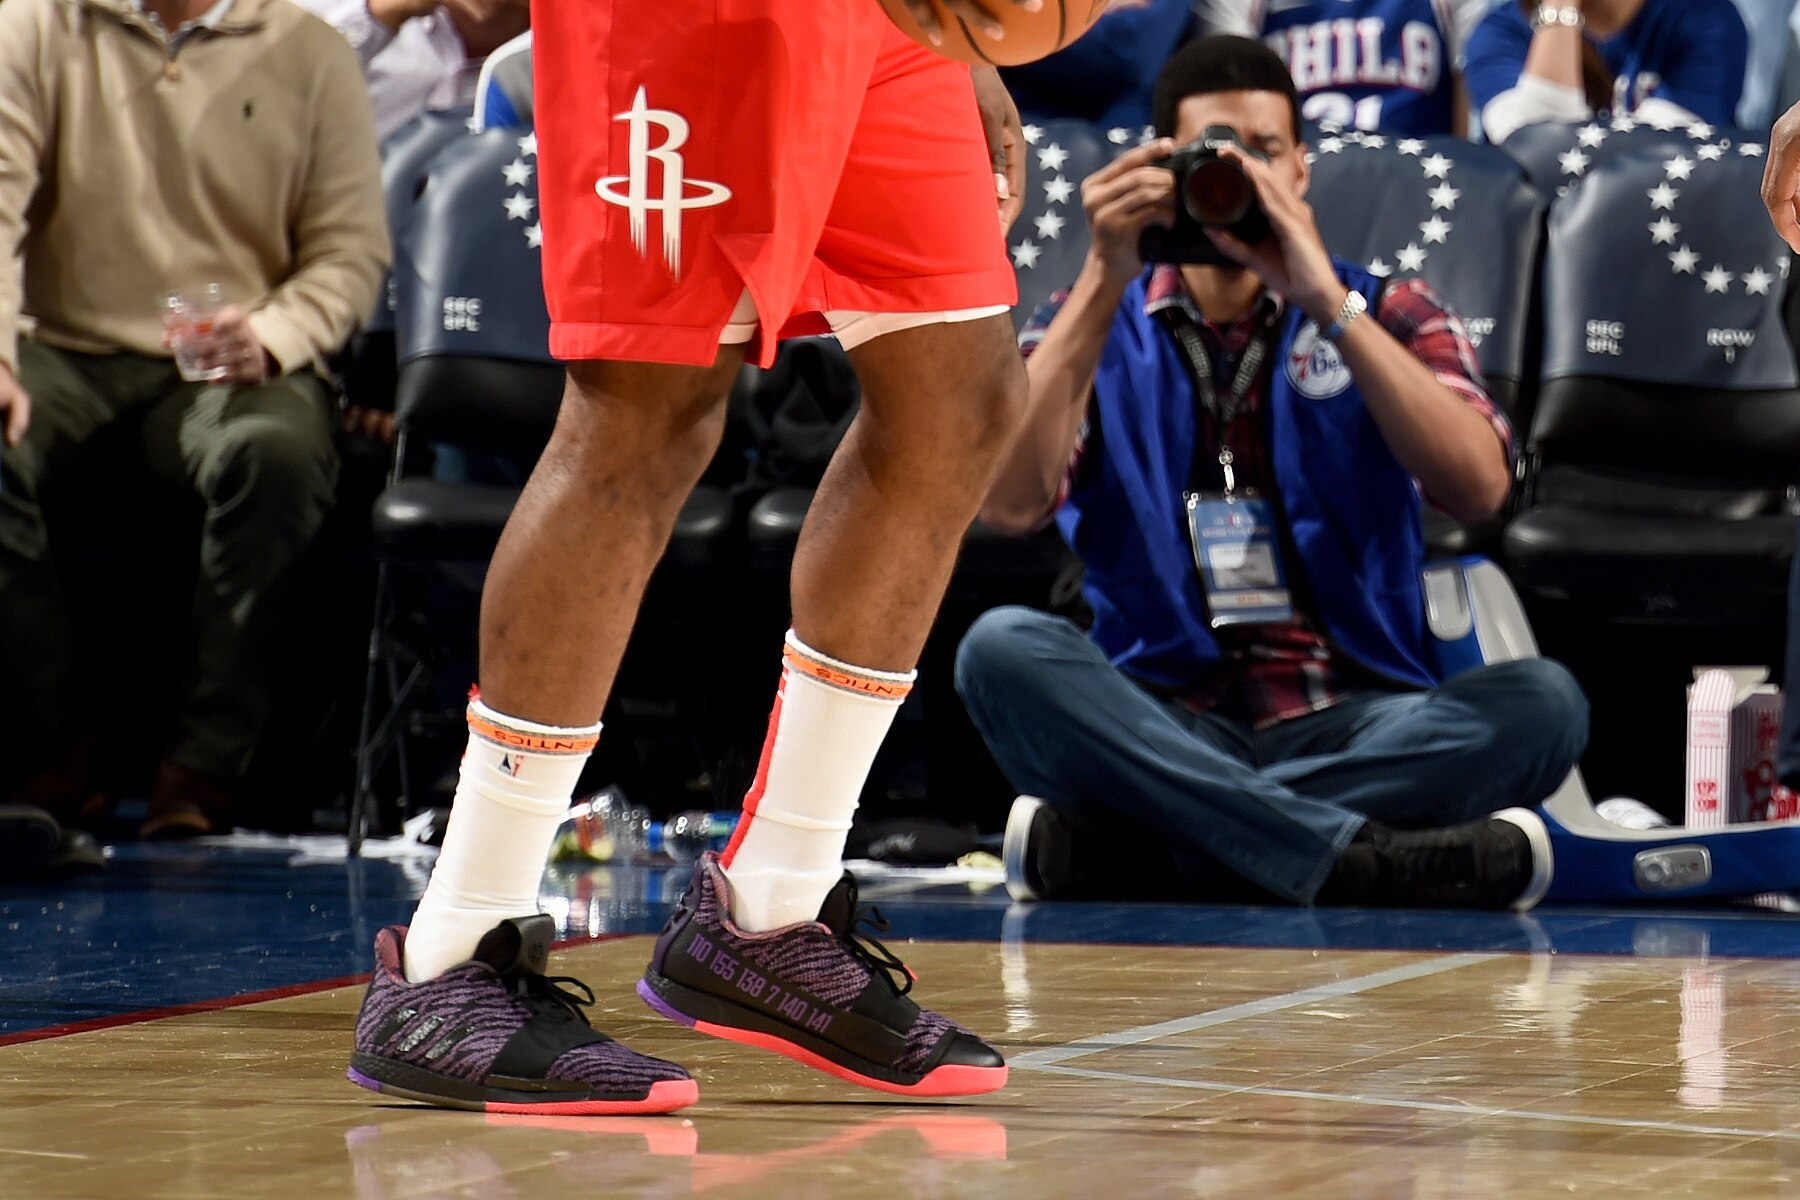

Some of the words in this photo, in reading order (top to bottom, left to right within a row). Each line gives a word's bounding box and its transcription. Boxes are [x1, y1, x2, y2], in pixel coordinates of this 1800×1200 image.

[1463, 317, 1497, 335] EAT
[1706, 328, 1756, 347] ROW
[686, 933, 713, 963] 110
[709, 949, 740, 981] 155
[736, 967, 767, 998] 138
[764, 985, 781, 1004] 7
[776, 992, 808, 1021] 140
[805, 1007, 834, 1033] 141
